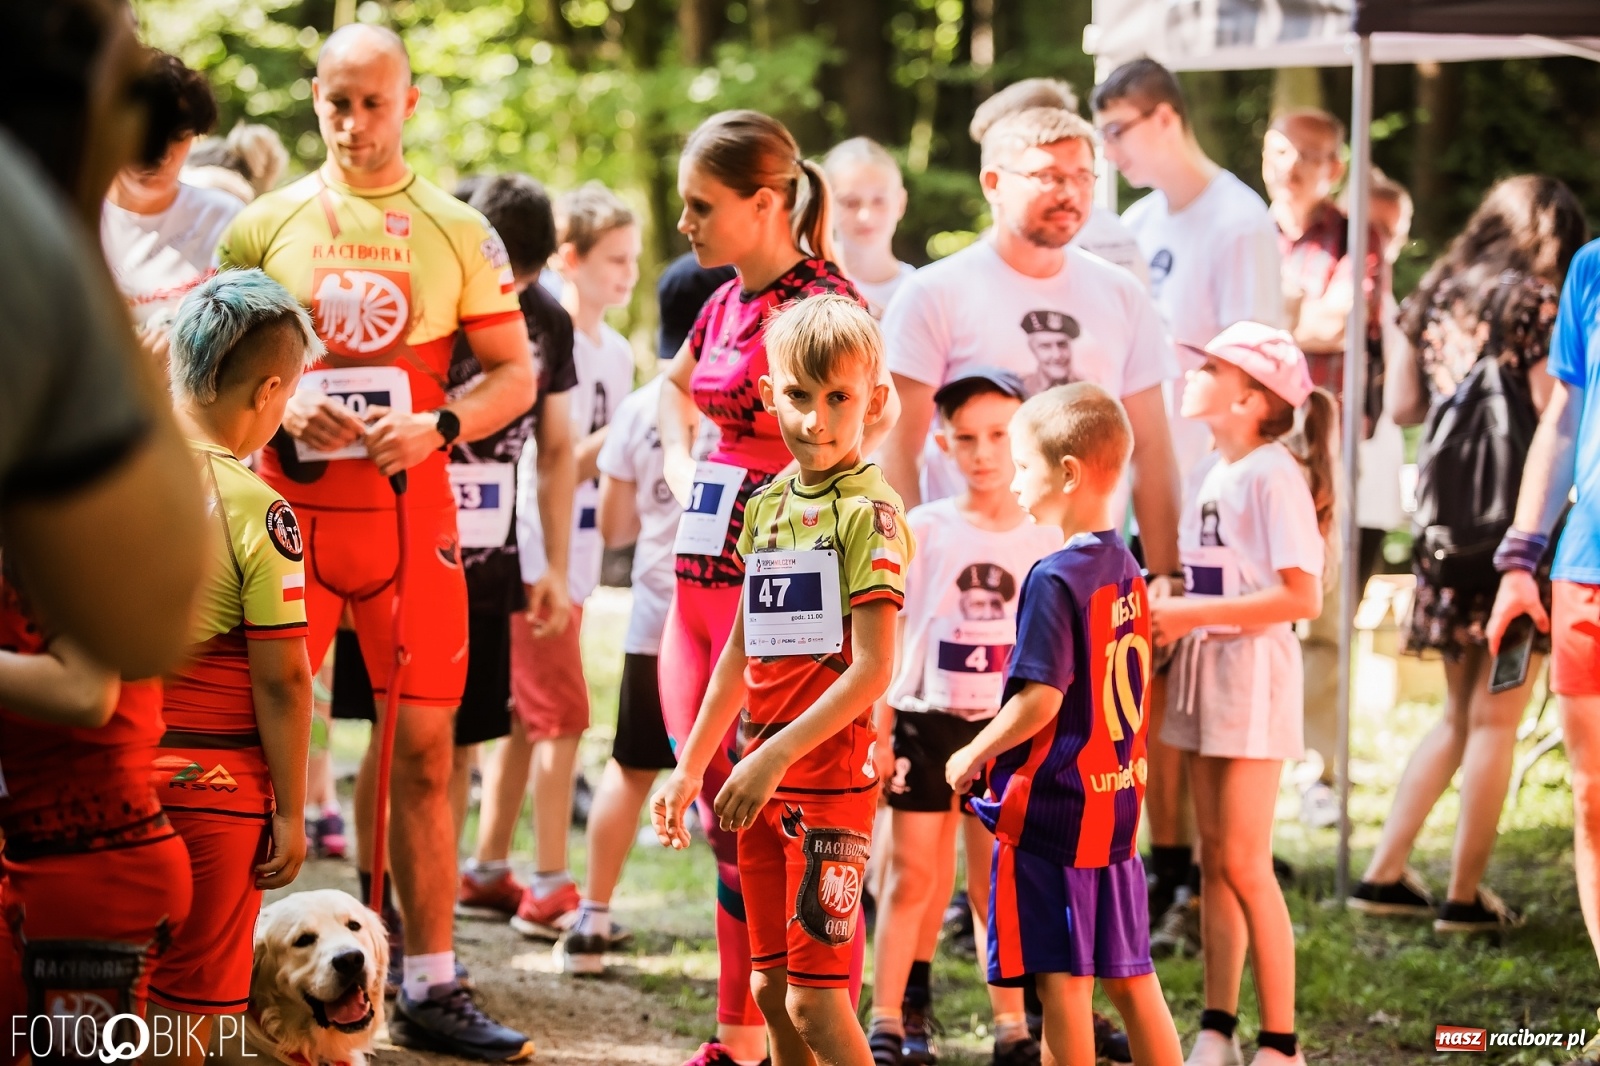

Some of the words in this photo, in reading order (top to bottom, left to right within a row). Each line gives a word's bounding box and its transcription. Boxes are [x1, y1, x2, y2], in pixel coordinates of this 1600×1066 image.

[330, 394, 367, 421] 0
[758, 578, 791, 607] 47
[791, 614, 806, 622] godz.
[964, 646, 989, 672] 4
[1105, 633, 1149, 741] 10
[169, 781, 239, 793] RSW
[825, 919, 849, 936] OCR
